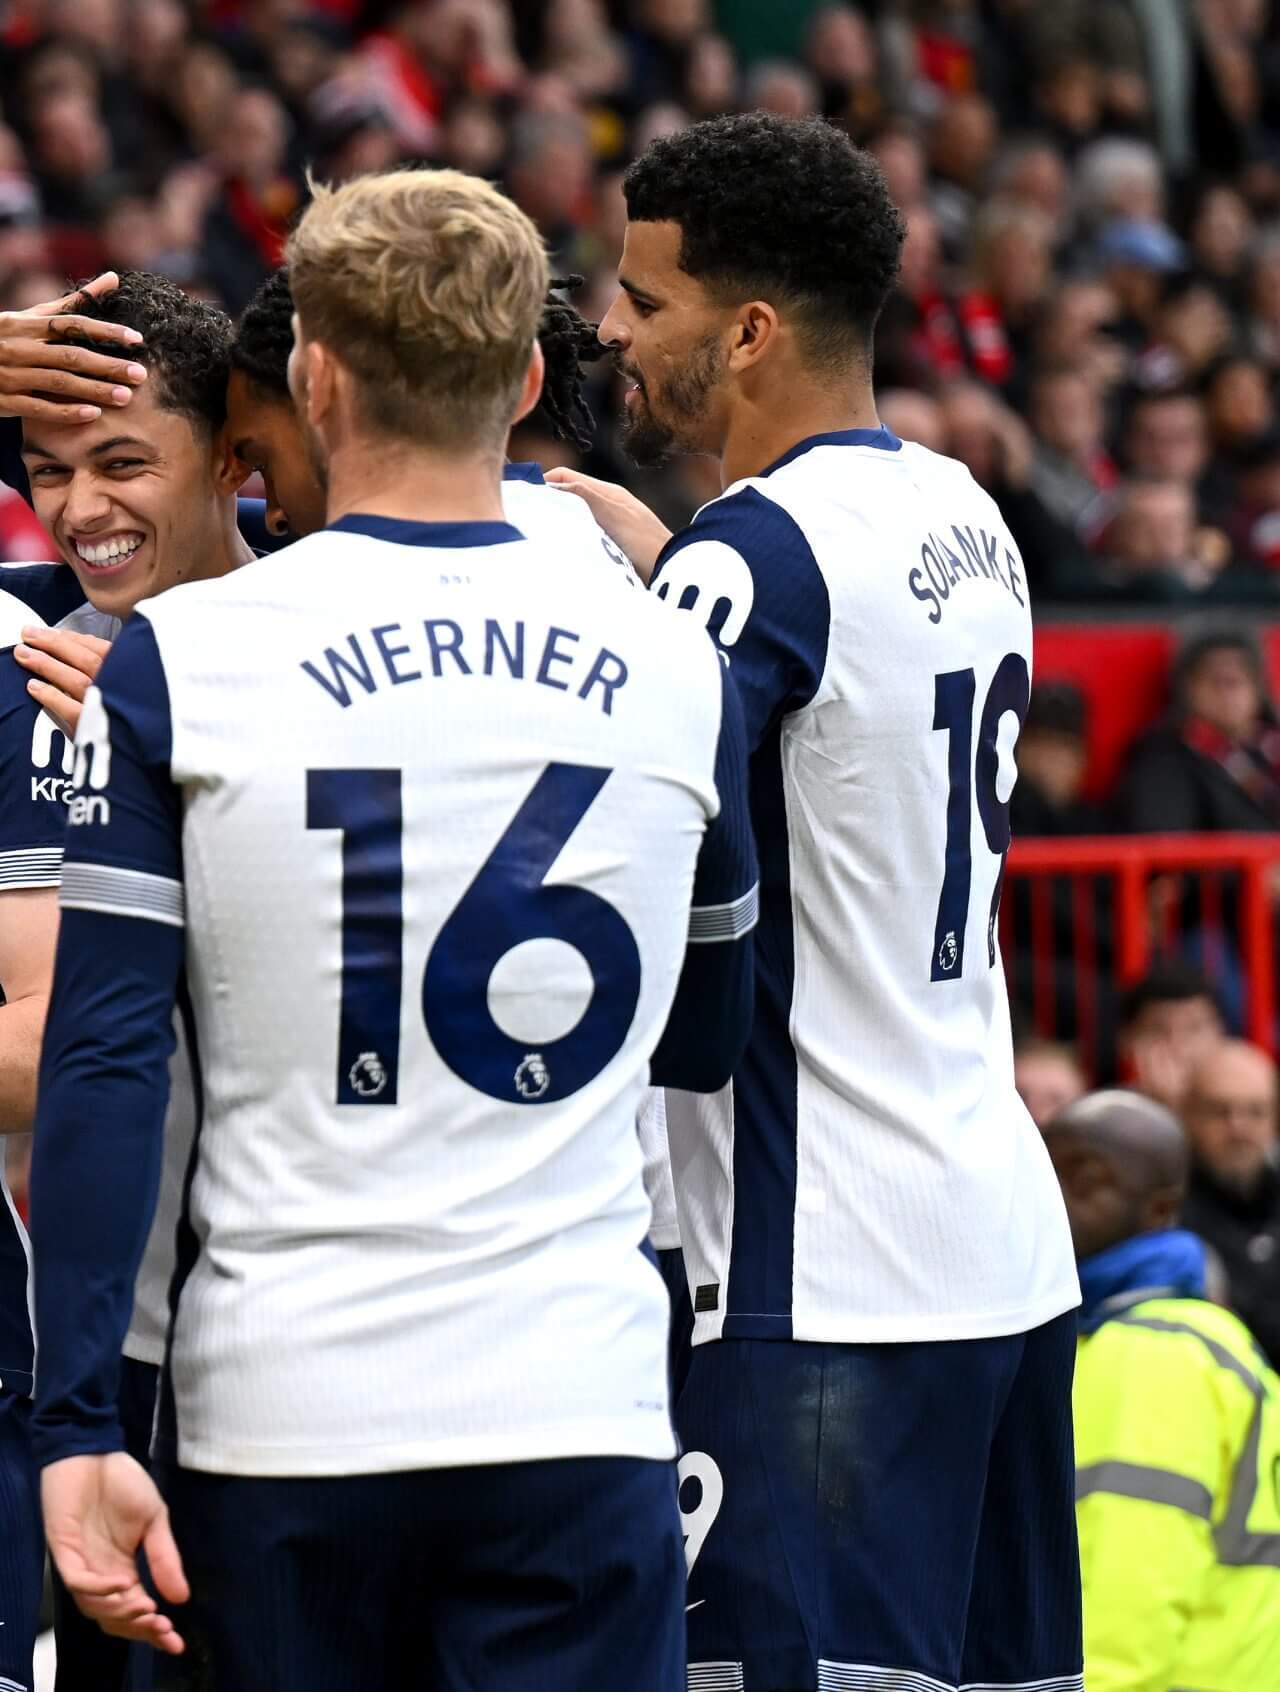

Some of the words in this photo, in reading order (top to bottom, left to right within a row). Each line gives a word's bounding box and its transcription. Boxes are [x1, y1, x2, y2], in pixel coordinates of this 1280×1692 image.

[300, 618, 628, 716] WERNER
[909, 524, 1025, 624] SOLANKE
[930, 652, 1031, 983] 19
[305, 761, 642, 1106] 16
